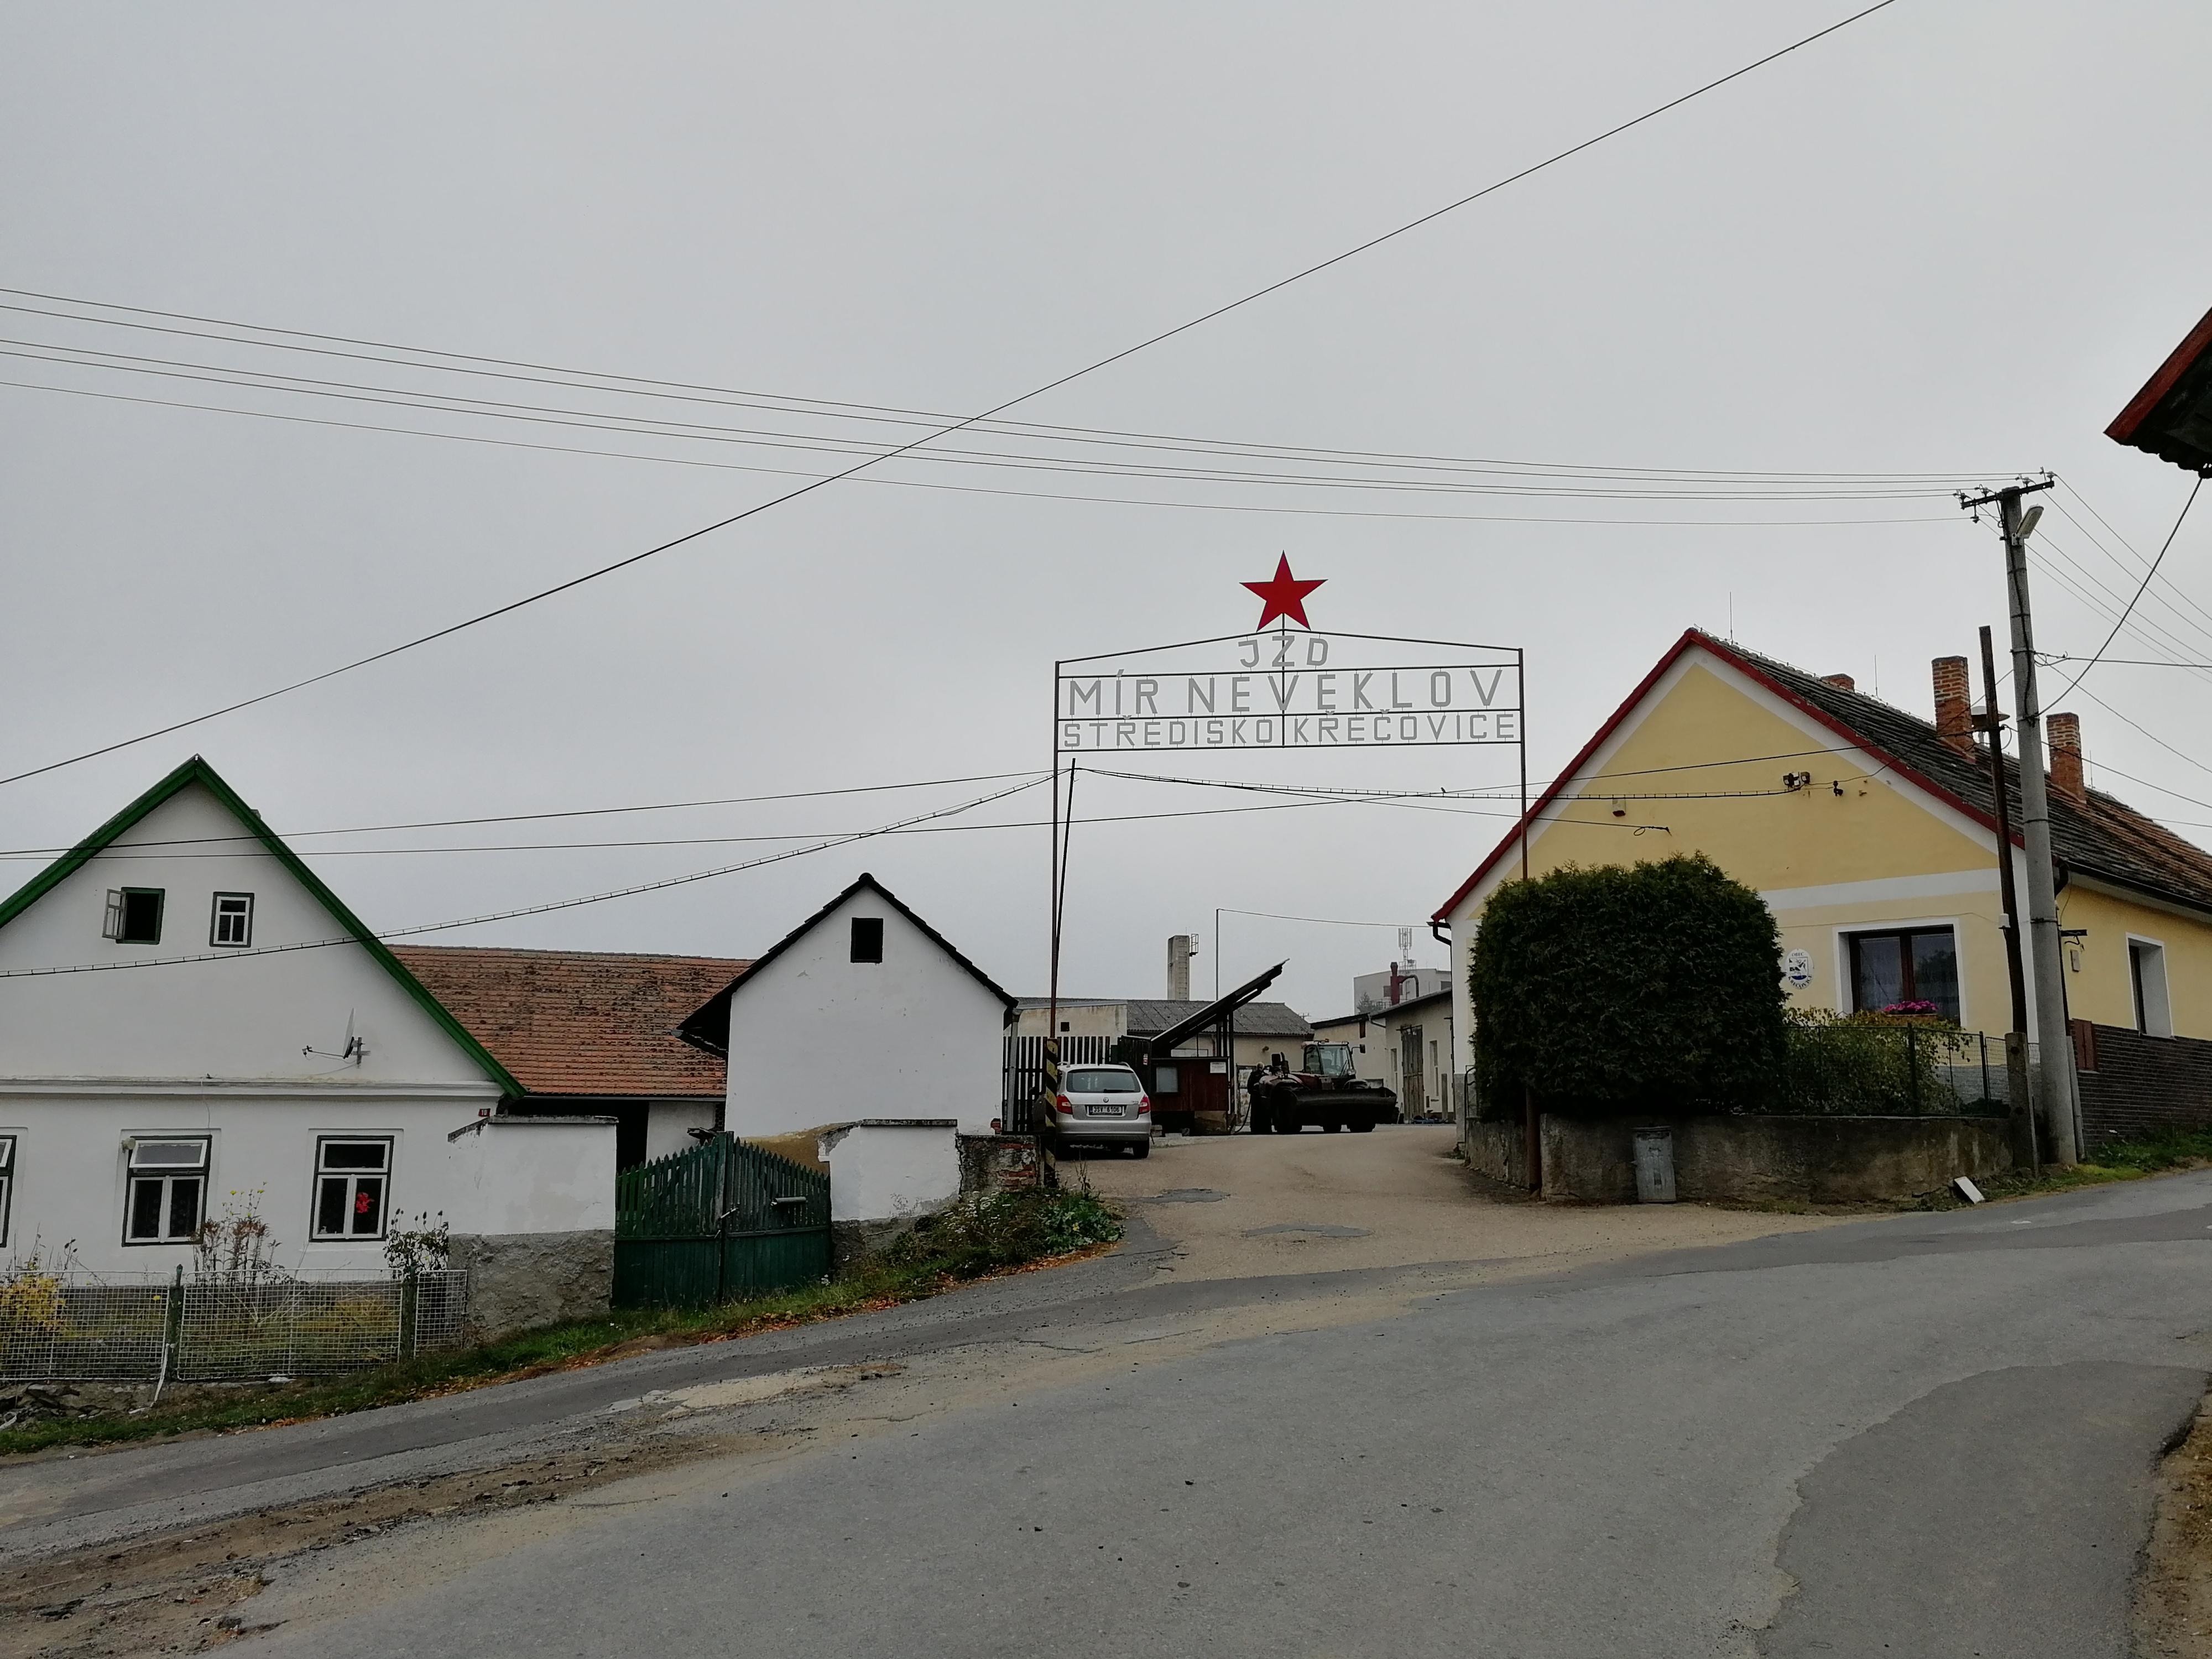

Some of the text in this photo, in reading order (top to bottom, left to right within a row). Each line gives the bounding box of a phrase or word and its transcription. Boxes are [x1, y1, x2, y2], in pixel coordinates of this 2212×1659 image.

[1238, 635, 1328, 667] JZD
[1070, 669, 1503, 715] MÍR NEVEKLOV
[1065, 708, 1515, 747] STŘEDISKO KŘEČOVICE
